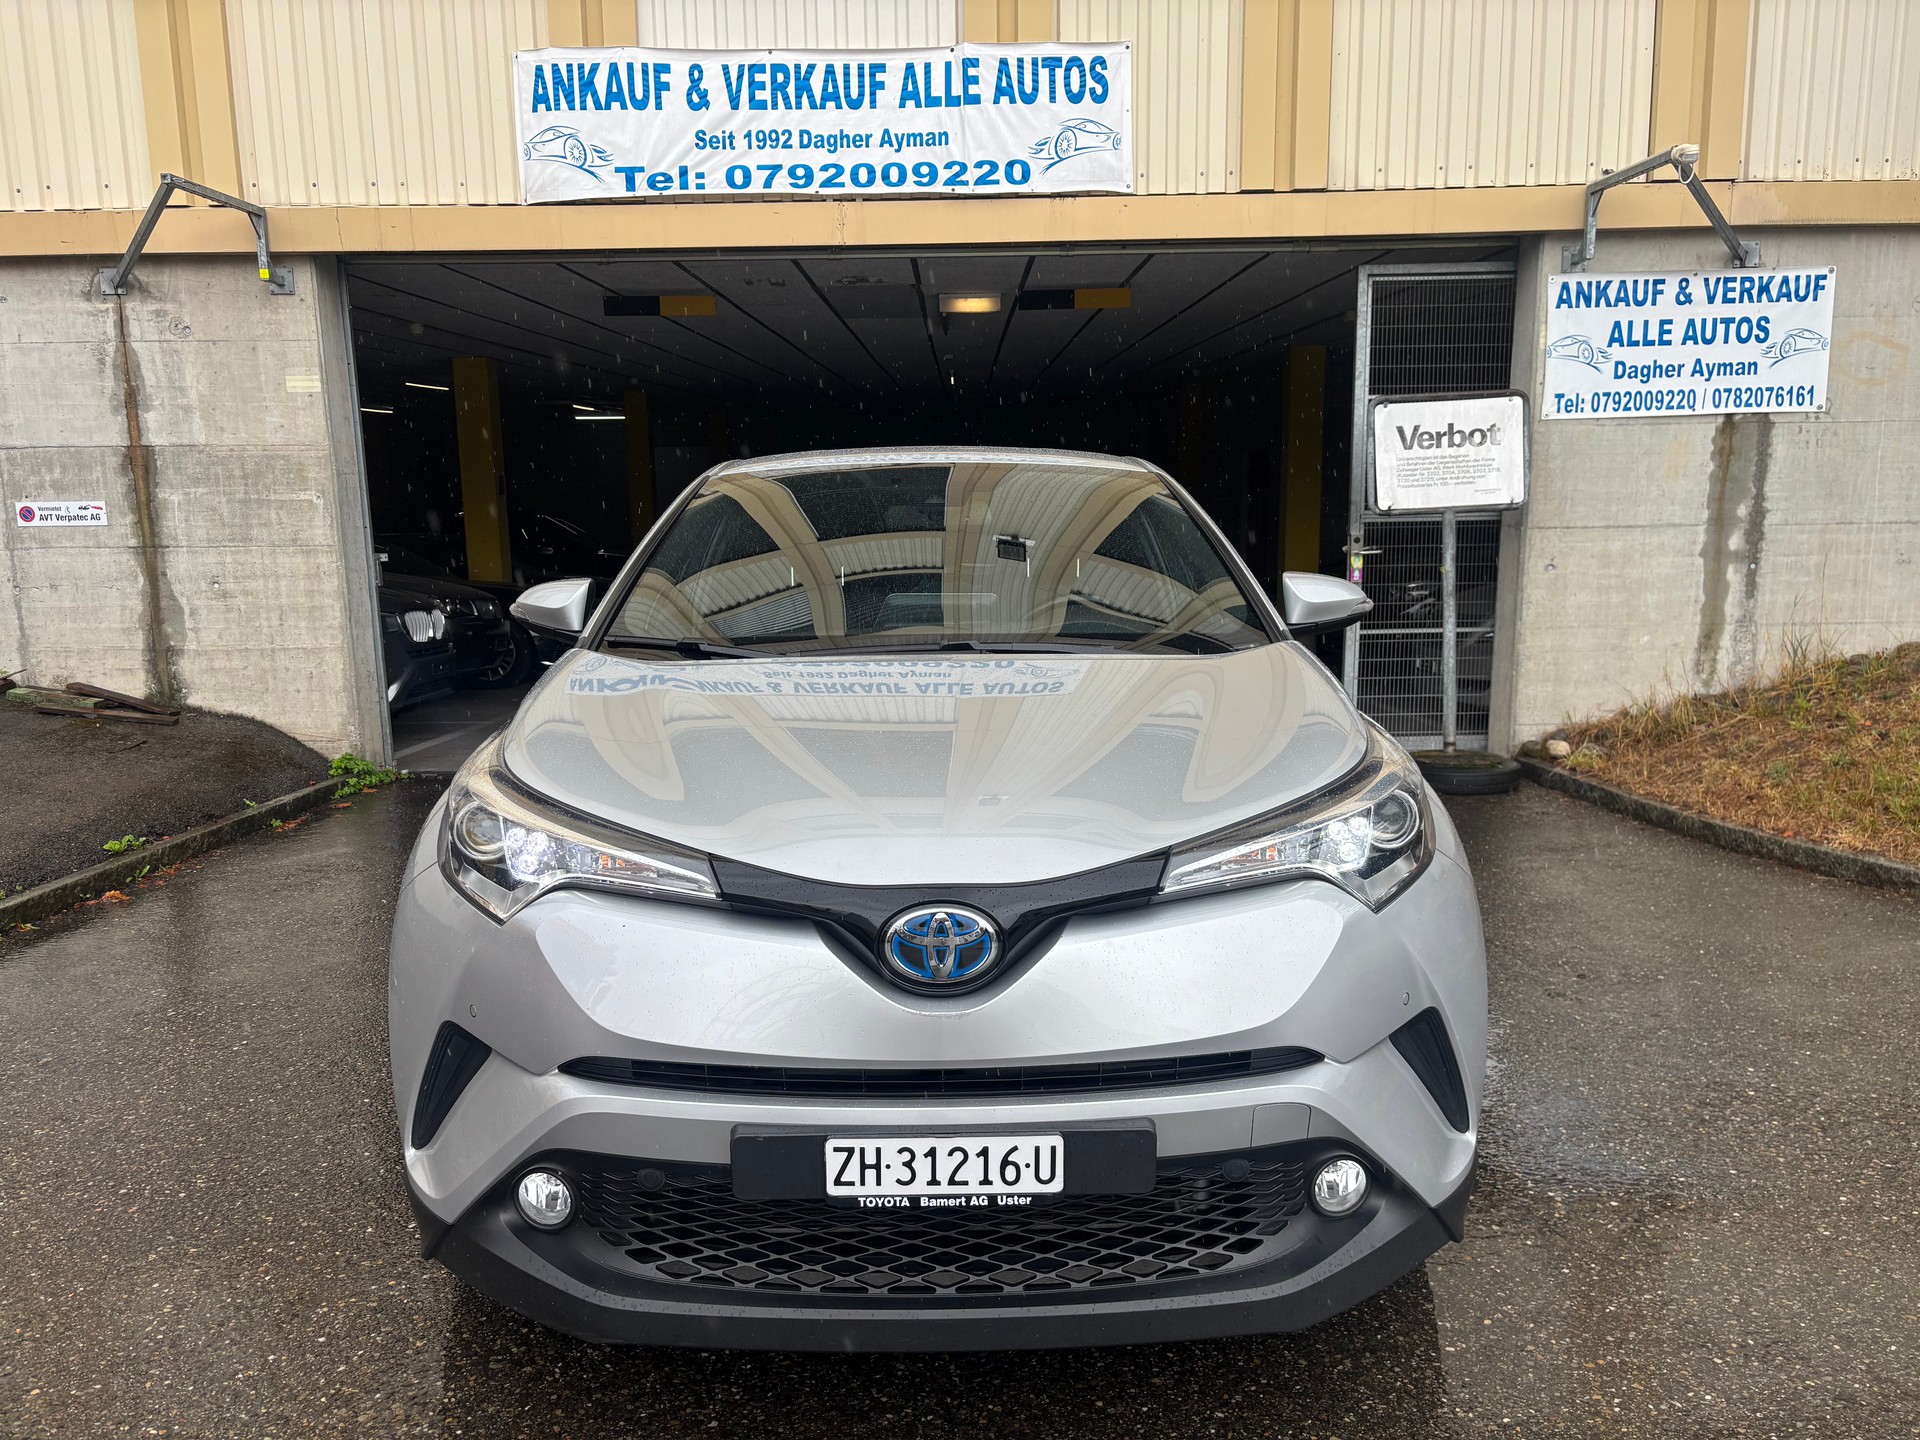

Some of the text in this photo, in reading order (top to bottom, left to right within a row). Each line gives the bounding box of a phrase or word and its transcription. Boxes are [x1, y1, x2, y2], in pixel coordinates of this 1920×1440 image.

[530, 55, 1109, 113] ANKAUF & VERKAUF ALLE AUTOS
[694, 127, 950, 154] Seit 1992 Dagher Ayman
[614, 159, 1031, 191] Tel: 0792009220
[1555, 274, 1828, 309] ANKAUF & VERKAUF
[1607, 316, 1771, 348] ALLE AUTOS
[1613, 358, 1758, 384] Dagher Ayman
[1554, 385, 1815, 413] Tel: 0792009220 / 0782076161
[1395, 423, 1501, 450] Verbot
[39, 513, 101, 522] AVT Verpatec AG
[858, 1195, 1032, 1208] TOYOTA Bamert AG Uster
